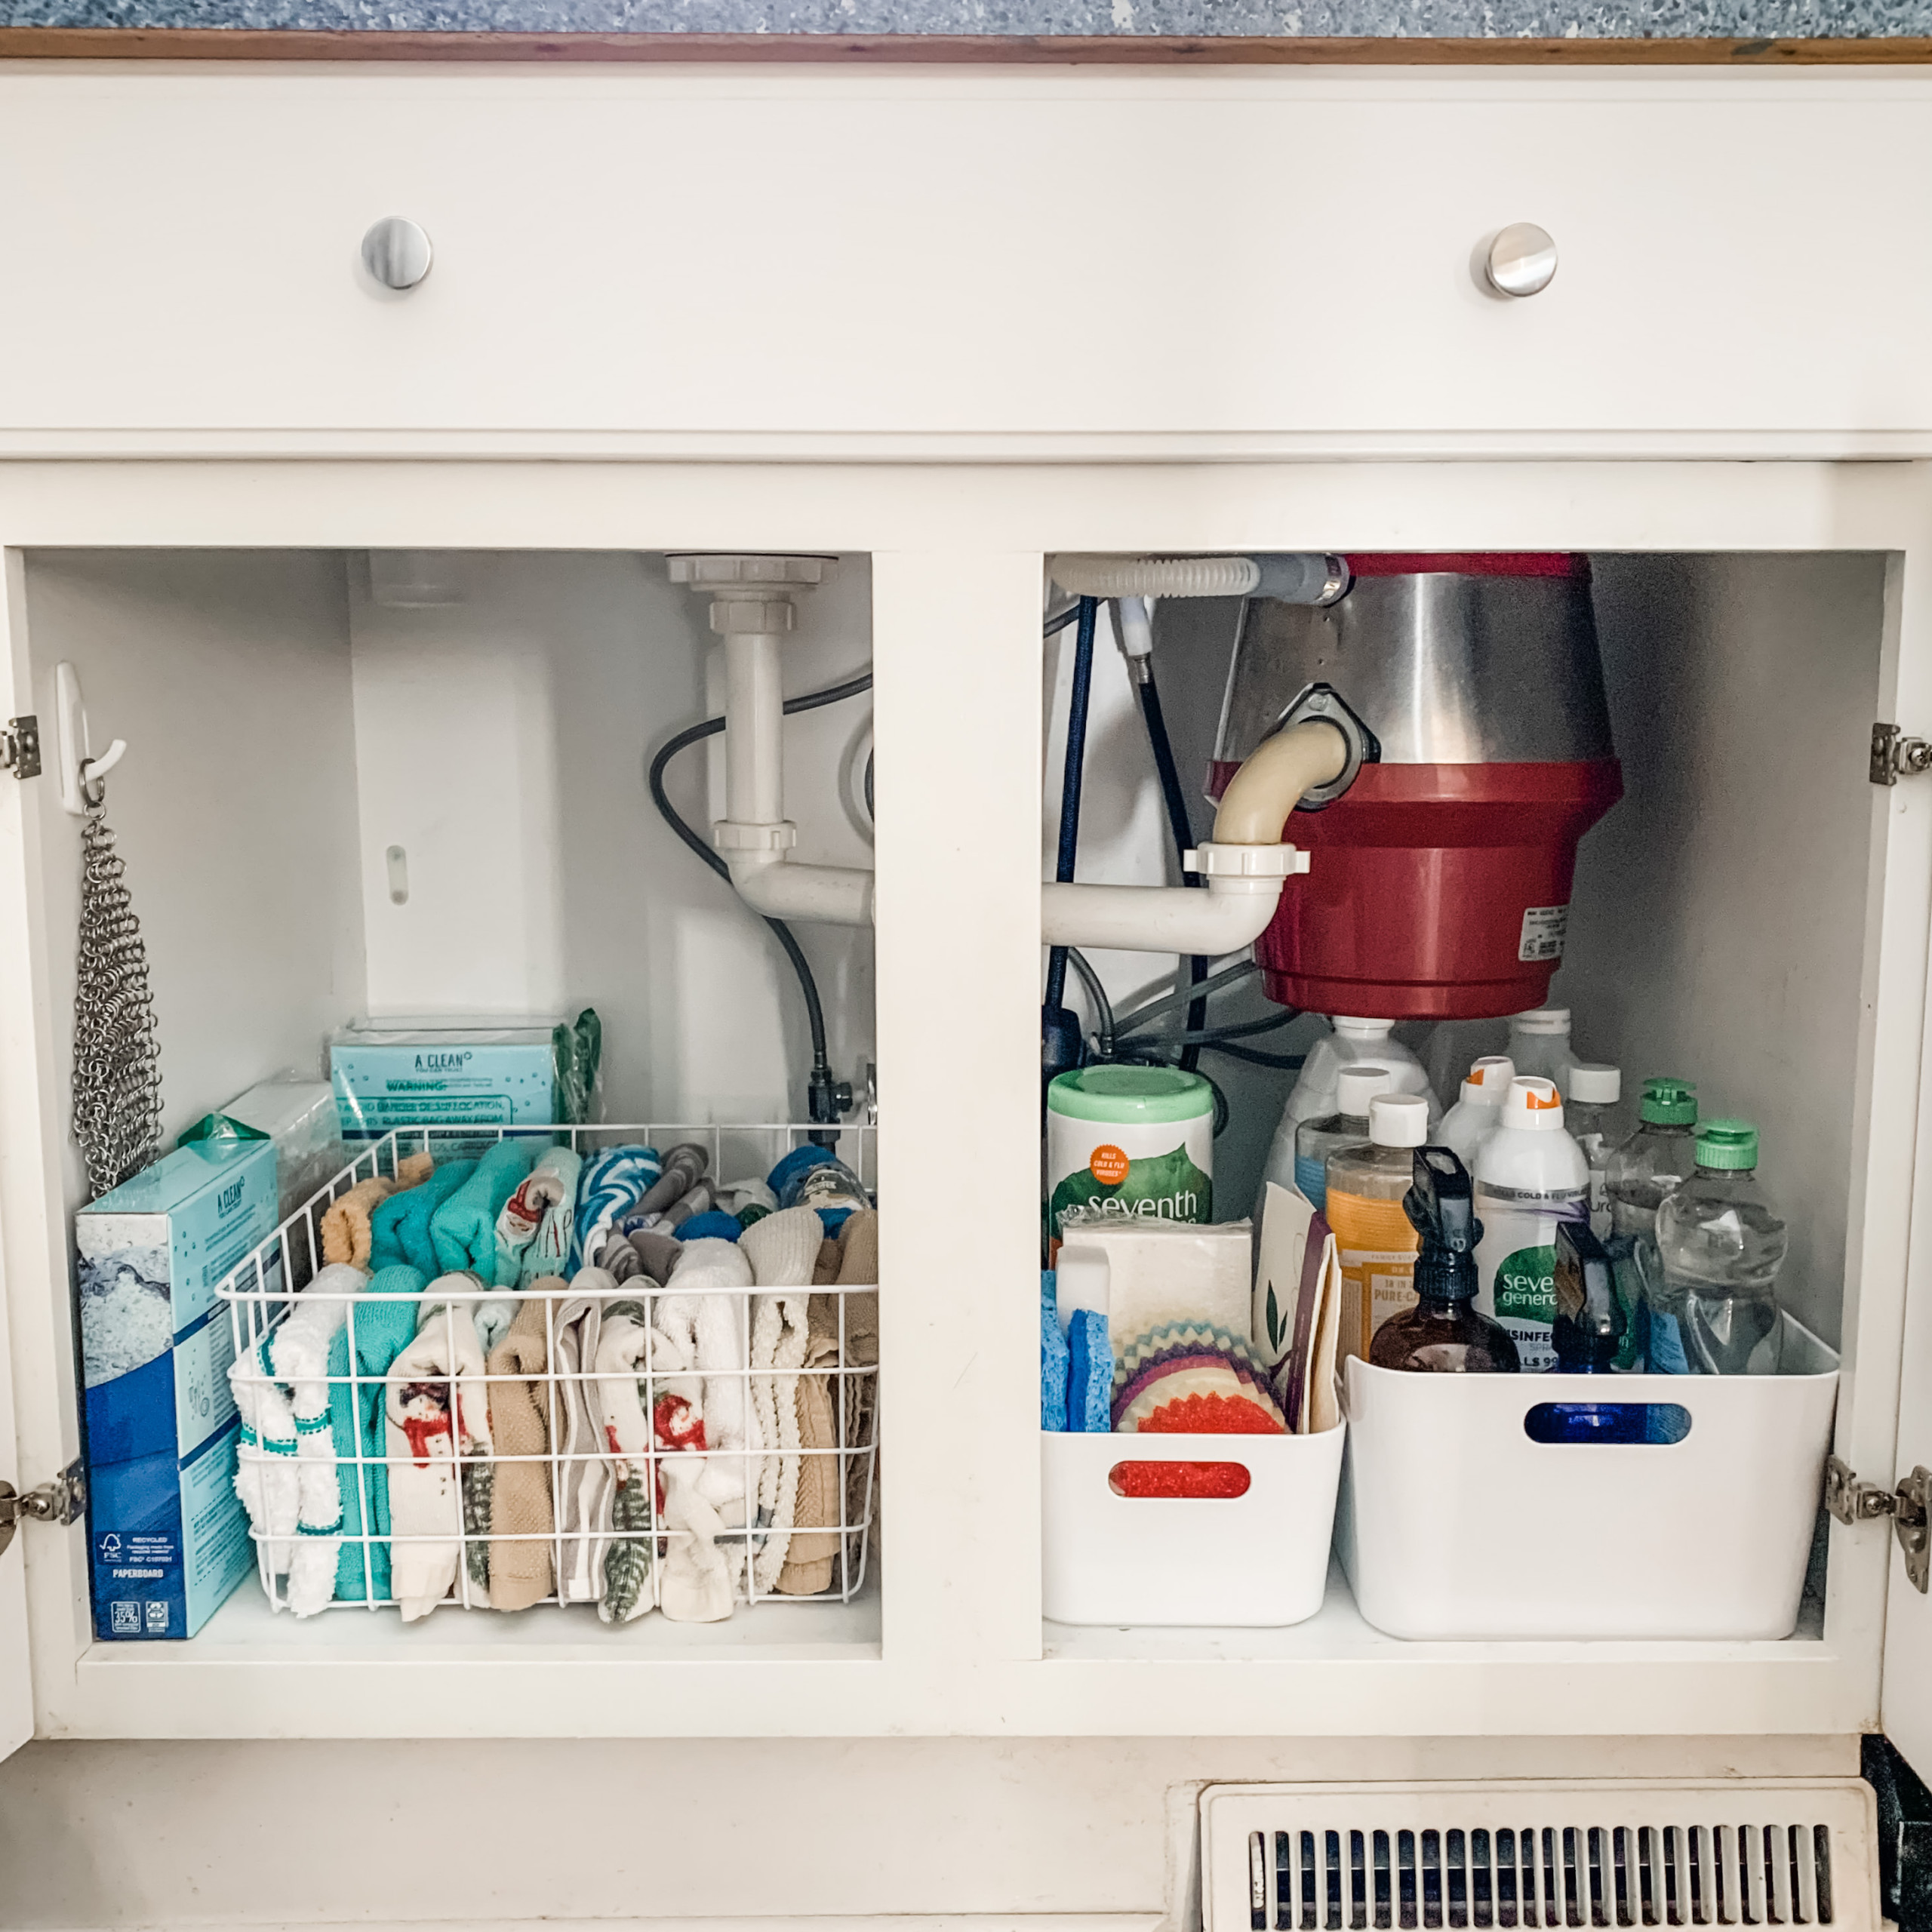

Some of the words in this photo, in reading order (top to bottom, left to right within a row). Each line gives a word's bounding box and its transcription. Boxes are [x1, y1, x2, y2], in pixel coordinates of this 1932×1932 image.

[415, 1054, 422, 1068] A
[428, 1054, 463, 1068] CLEAN
[1094, 1160, 1108, 1168] COLD
[1518, 1192, 1541, 1200] COLD
[1088, 1189, 1197, 1219] seventh
[112, 1569, 164, 1578] PAPERBOARD
[115, 1611, 137, 1623] 35%
